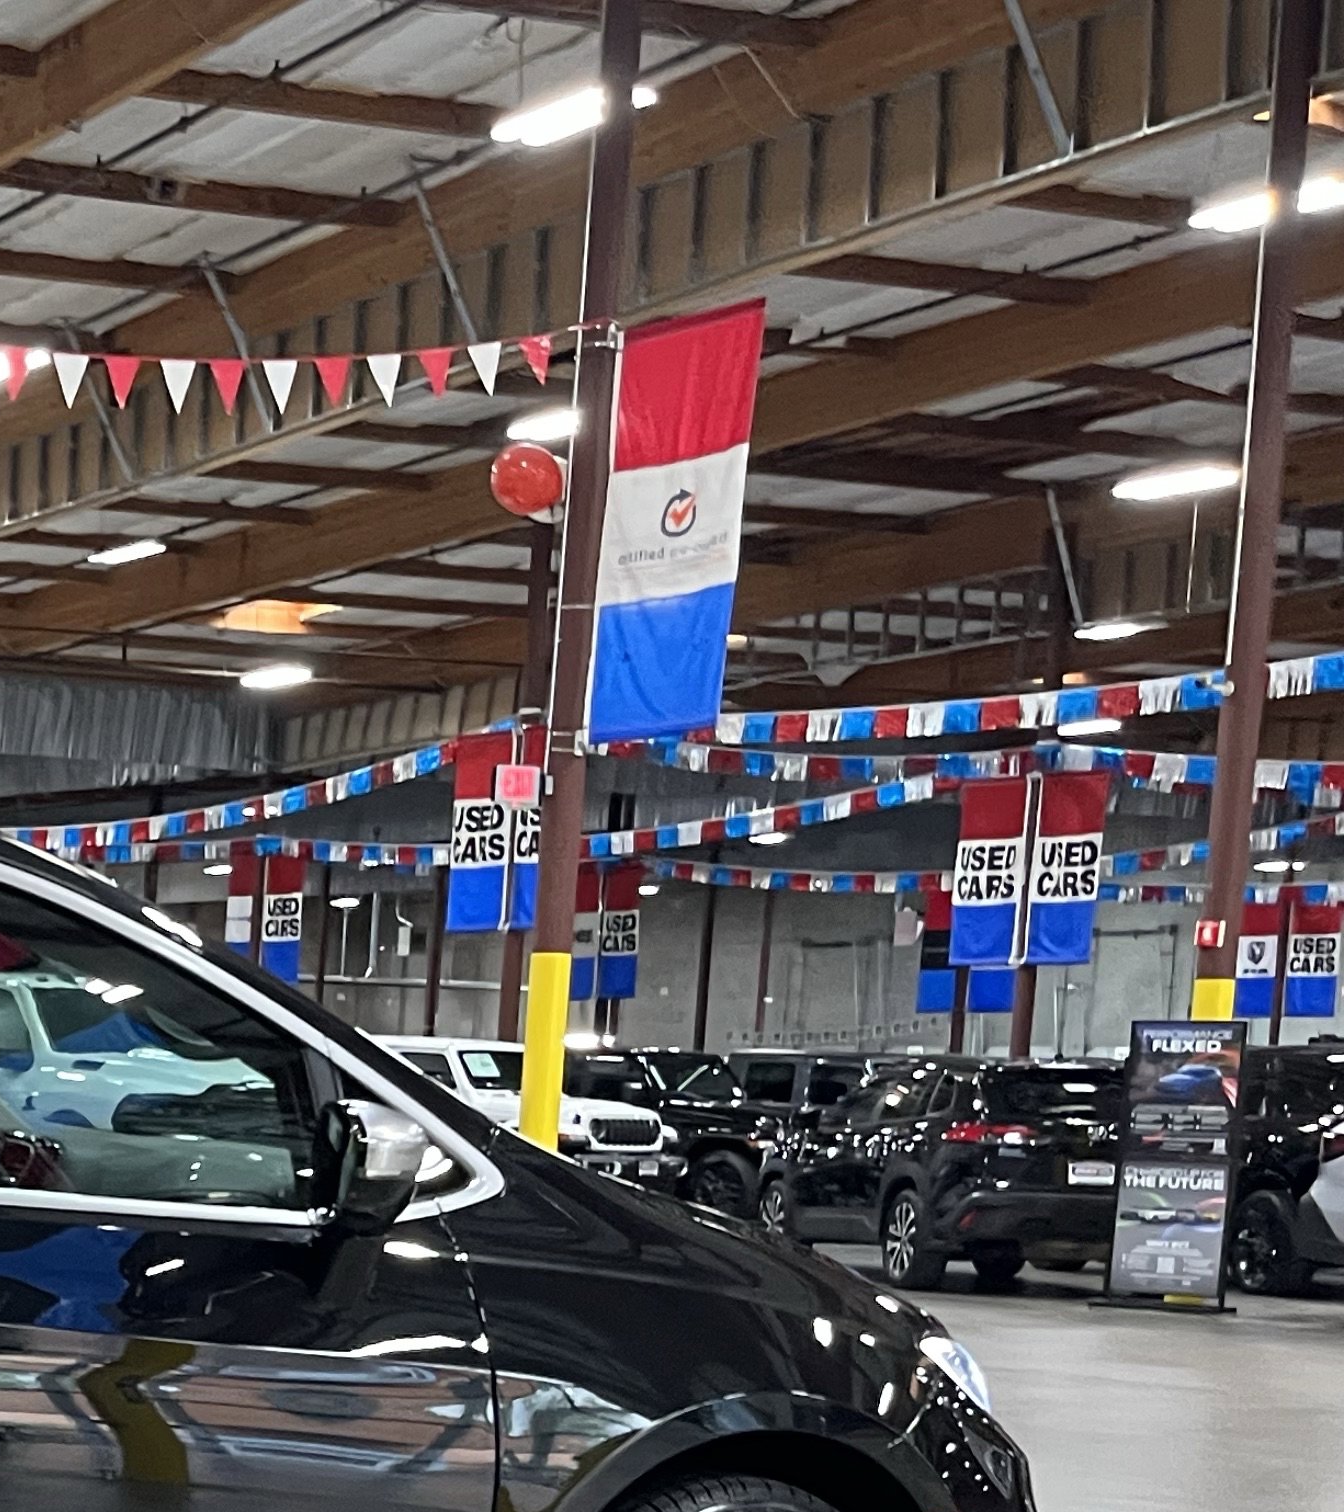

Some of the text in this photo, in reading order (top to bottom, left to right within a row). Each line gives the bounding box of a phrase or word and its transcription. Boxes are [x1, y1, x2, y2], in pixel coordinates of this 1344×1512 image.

[455, 804, 505, 833] USED
[453, 833, 505, 863] CARS
[961, 844, 1017, 871] USED
[1041, 840, 1099, 867] USED
[957, 873, 1015, 900] CARS
[1036, 869, 1096, 897] CARS
[267, 897, 300, 917] USED
[265, 918, 300, 937] CARS
[605, 913, 637, 932] USED
[602, 933, 636, 952] CARS
[1293, 937, 1337, 955] USED
[1290, 956, 1335, 974] CARS
[1152, 1038, 1222, 1053] FLEXED
[1123, 1174, 1225, 1191] THE FUTURE
